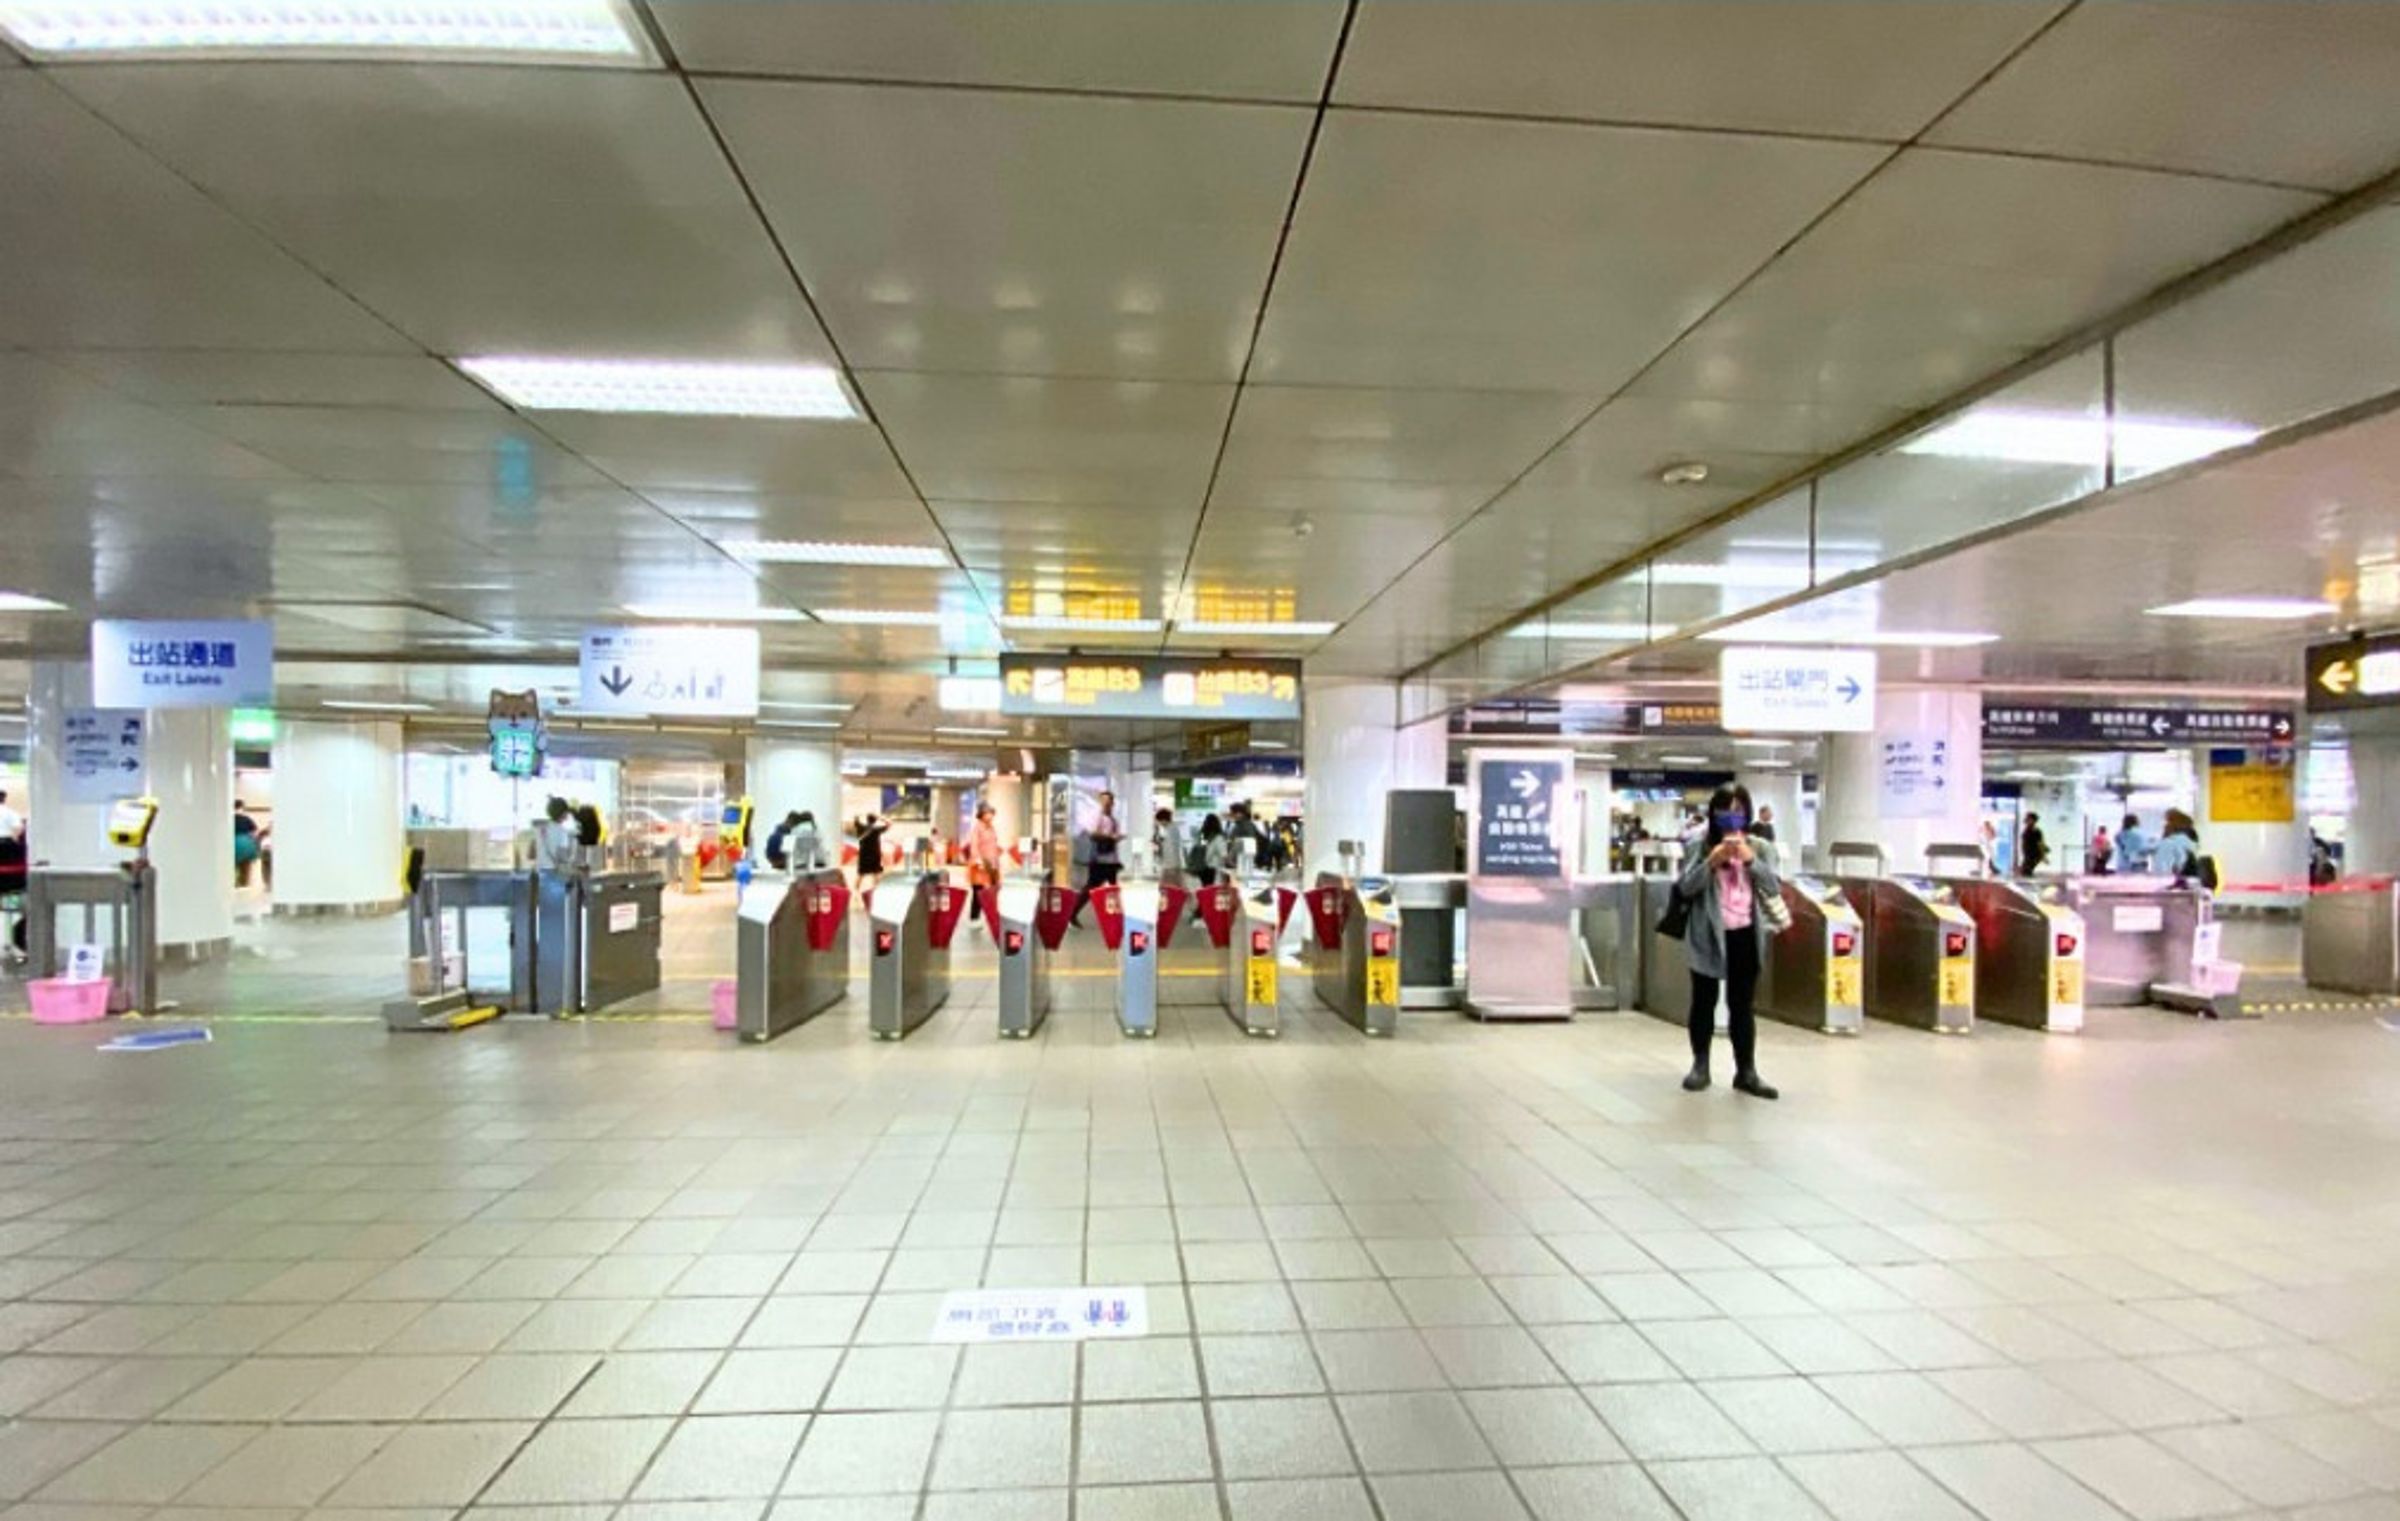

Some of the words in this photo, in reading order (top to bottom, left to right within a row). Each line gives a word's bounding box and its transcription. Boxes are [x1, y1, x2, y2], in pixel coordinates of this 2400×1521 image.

[128, 640, 237, 669] 出站通道
[143, 671, 172, 684] Exit
[175, 671, 222, 685] Lanes
